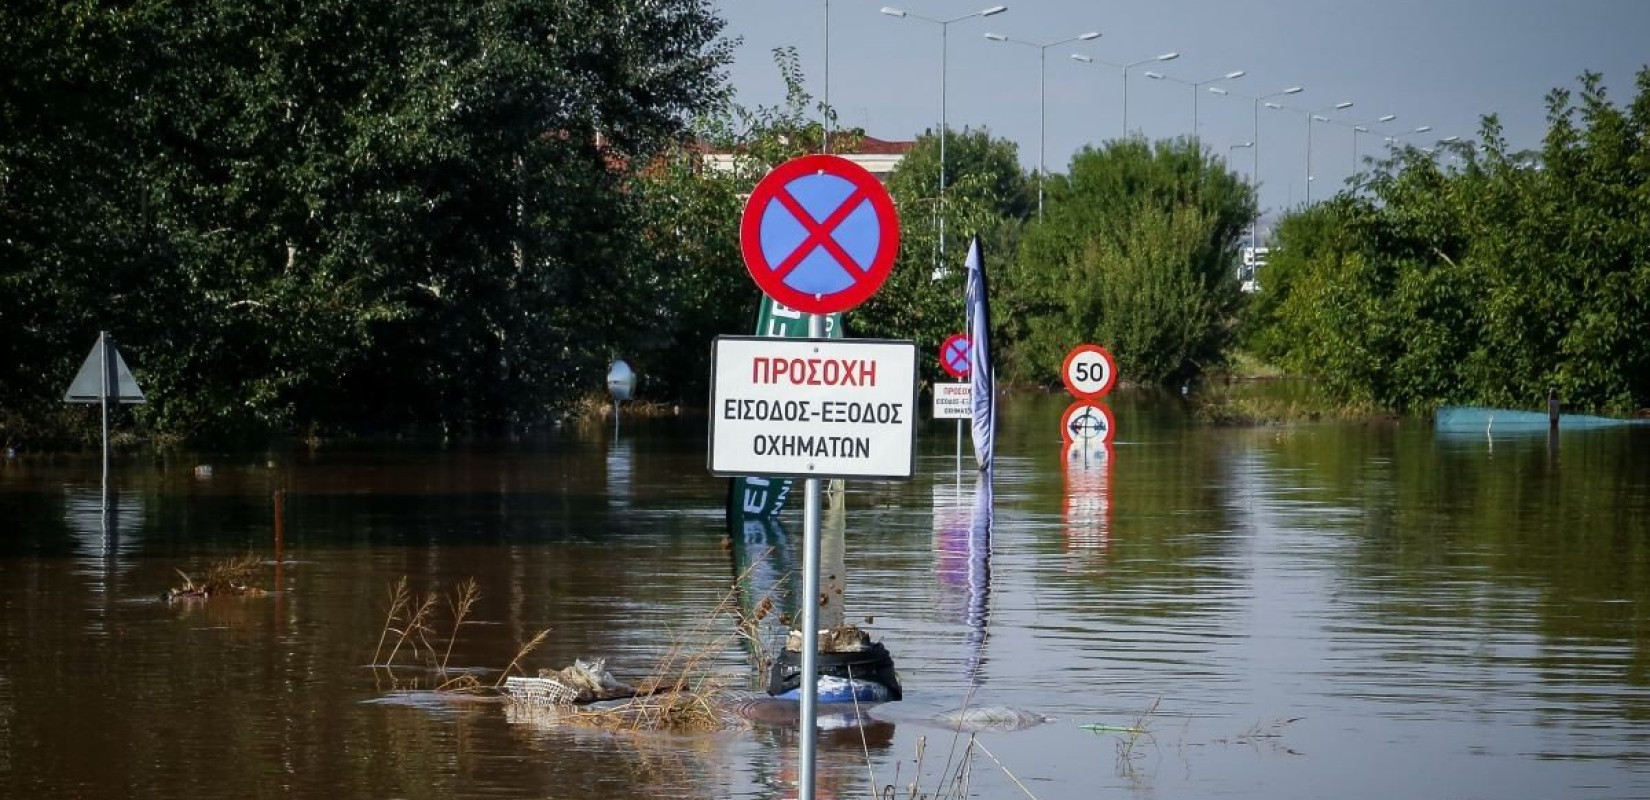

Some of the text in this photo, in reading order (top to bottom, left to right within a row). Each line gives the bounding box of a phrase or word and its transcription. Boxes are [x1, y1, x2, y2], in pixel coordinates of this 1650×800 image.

[752, 357, 877, 387] ΠΡΟΣΟΧΗ
[1076, 362, 1103, 382] 50
[943, 386, 972, 396] ΠΡΟΣΟΧ
[724, 399, 903, 424] ΕΙΣΟΔΟΣ-ΕΞΟΔΟΣ
[753, 434, 870, 458] ΟΧΗΜΑΤΩΝ
